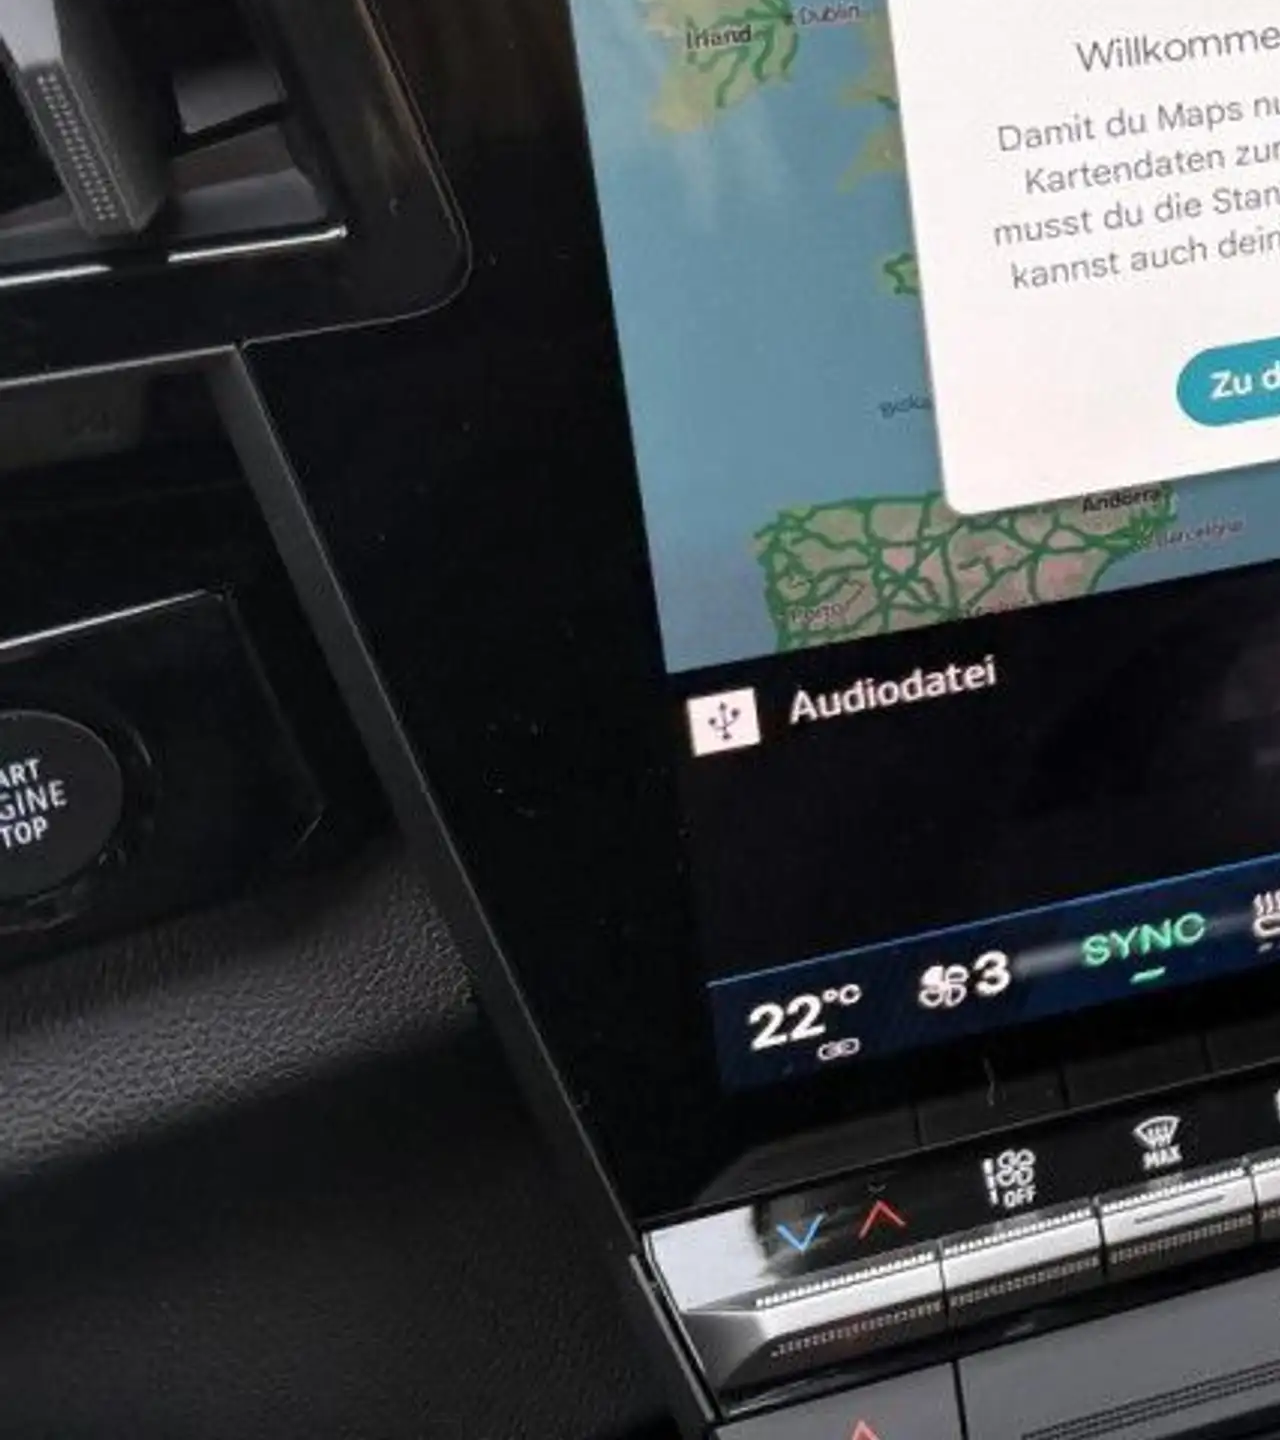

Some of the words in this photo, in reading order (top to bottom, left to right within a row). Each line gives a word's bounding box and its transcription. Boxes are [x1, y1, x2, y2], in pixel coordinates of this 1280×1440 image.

[800, 5, 859, 26] Dublin
[686, 25, 752, 50] Irland
[998, 116, 1094, 152] Damit
[1106, 109, 1148, 139] du
[1157, 99, 1244, 132] Maps
[1025, 147, 1225, 196] Kartendaten
[993, 211, 1093, 247] musst
[1103, 203, 1143, 231] du
[1154, 193, 1202, 222] die
[1011, 252, 1120, 290] kannst
[1130, 236, 1207, 273] auch
[1211, 371, 1252, 401] Zu
[1082, 487, 1162, 513] Andorra
[790, 655, 996, 725] Audiodatei
[0, 758, 41, 789] ART
[0, 780, 67, 822] GINE
[0, 817, 49, 850] TOP
[1081, 912, 1206, 968] SYNC
[973, 951, 1011, 997] 3
[1142, 1143, 1183, 1171] MAX
[1003, 1184, 1037, 1209] OFF
